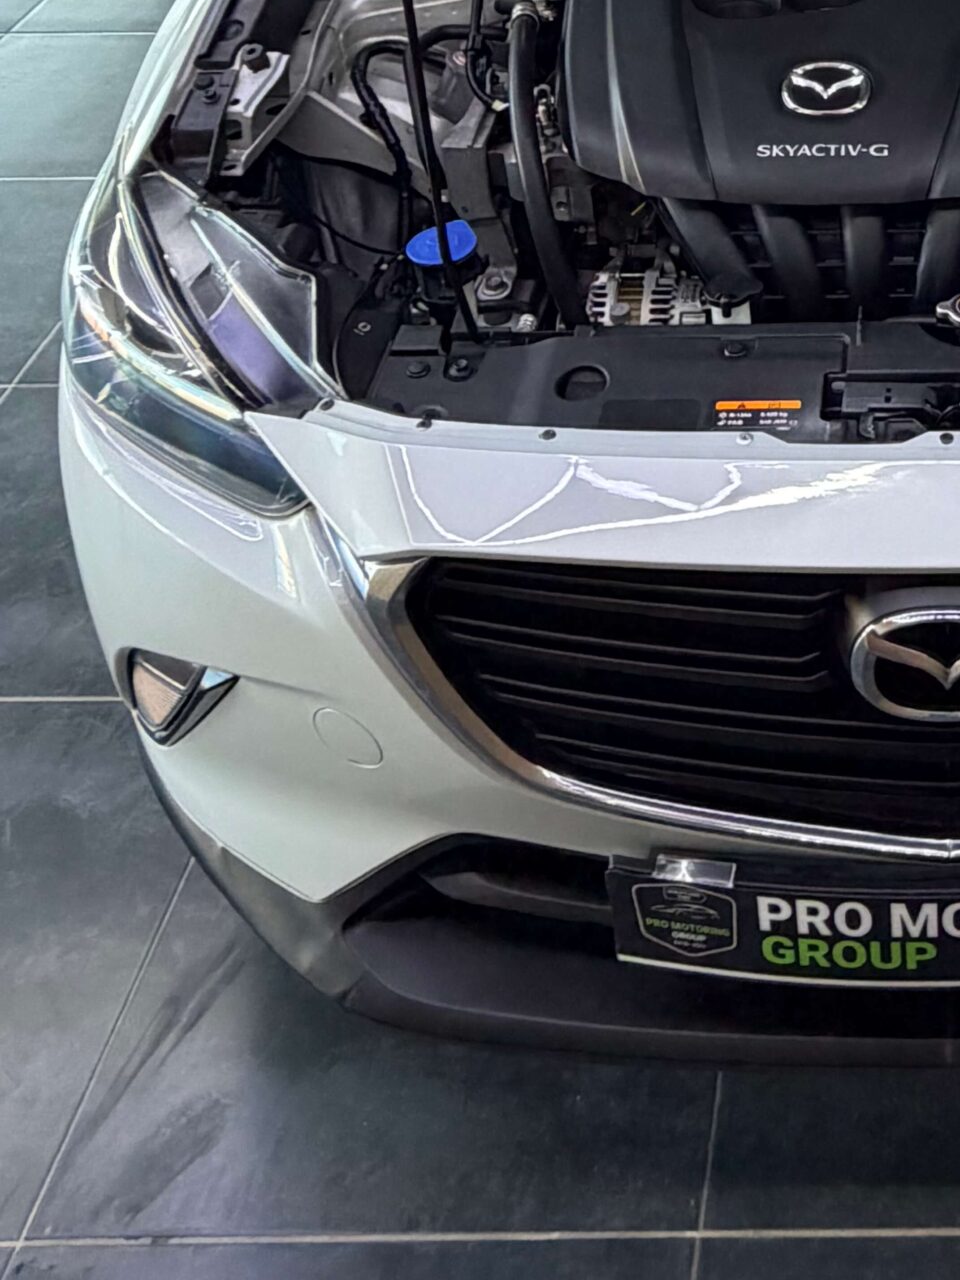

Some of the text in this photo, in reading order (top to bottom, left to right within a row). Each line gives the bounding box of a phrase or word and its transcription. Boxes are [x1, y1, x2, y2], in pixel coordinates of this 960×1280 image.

[756, 143, 889, 158] SKYACTIV-G
[756, 895, 873, 938] PRO
[761, 935, 937, 970] GROUP
